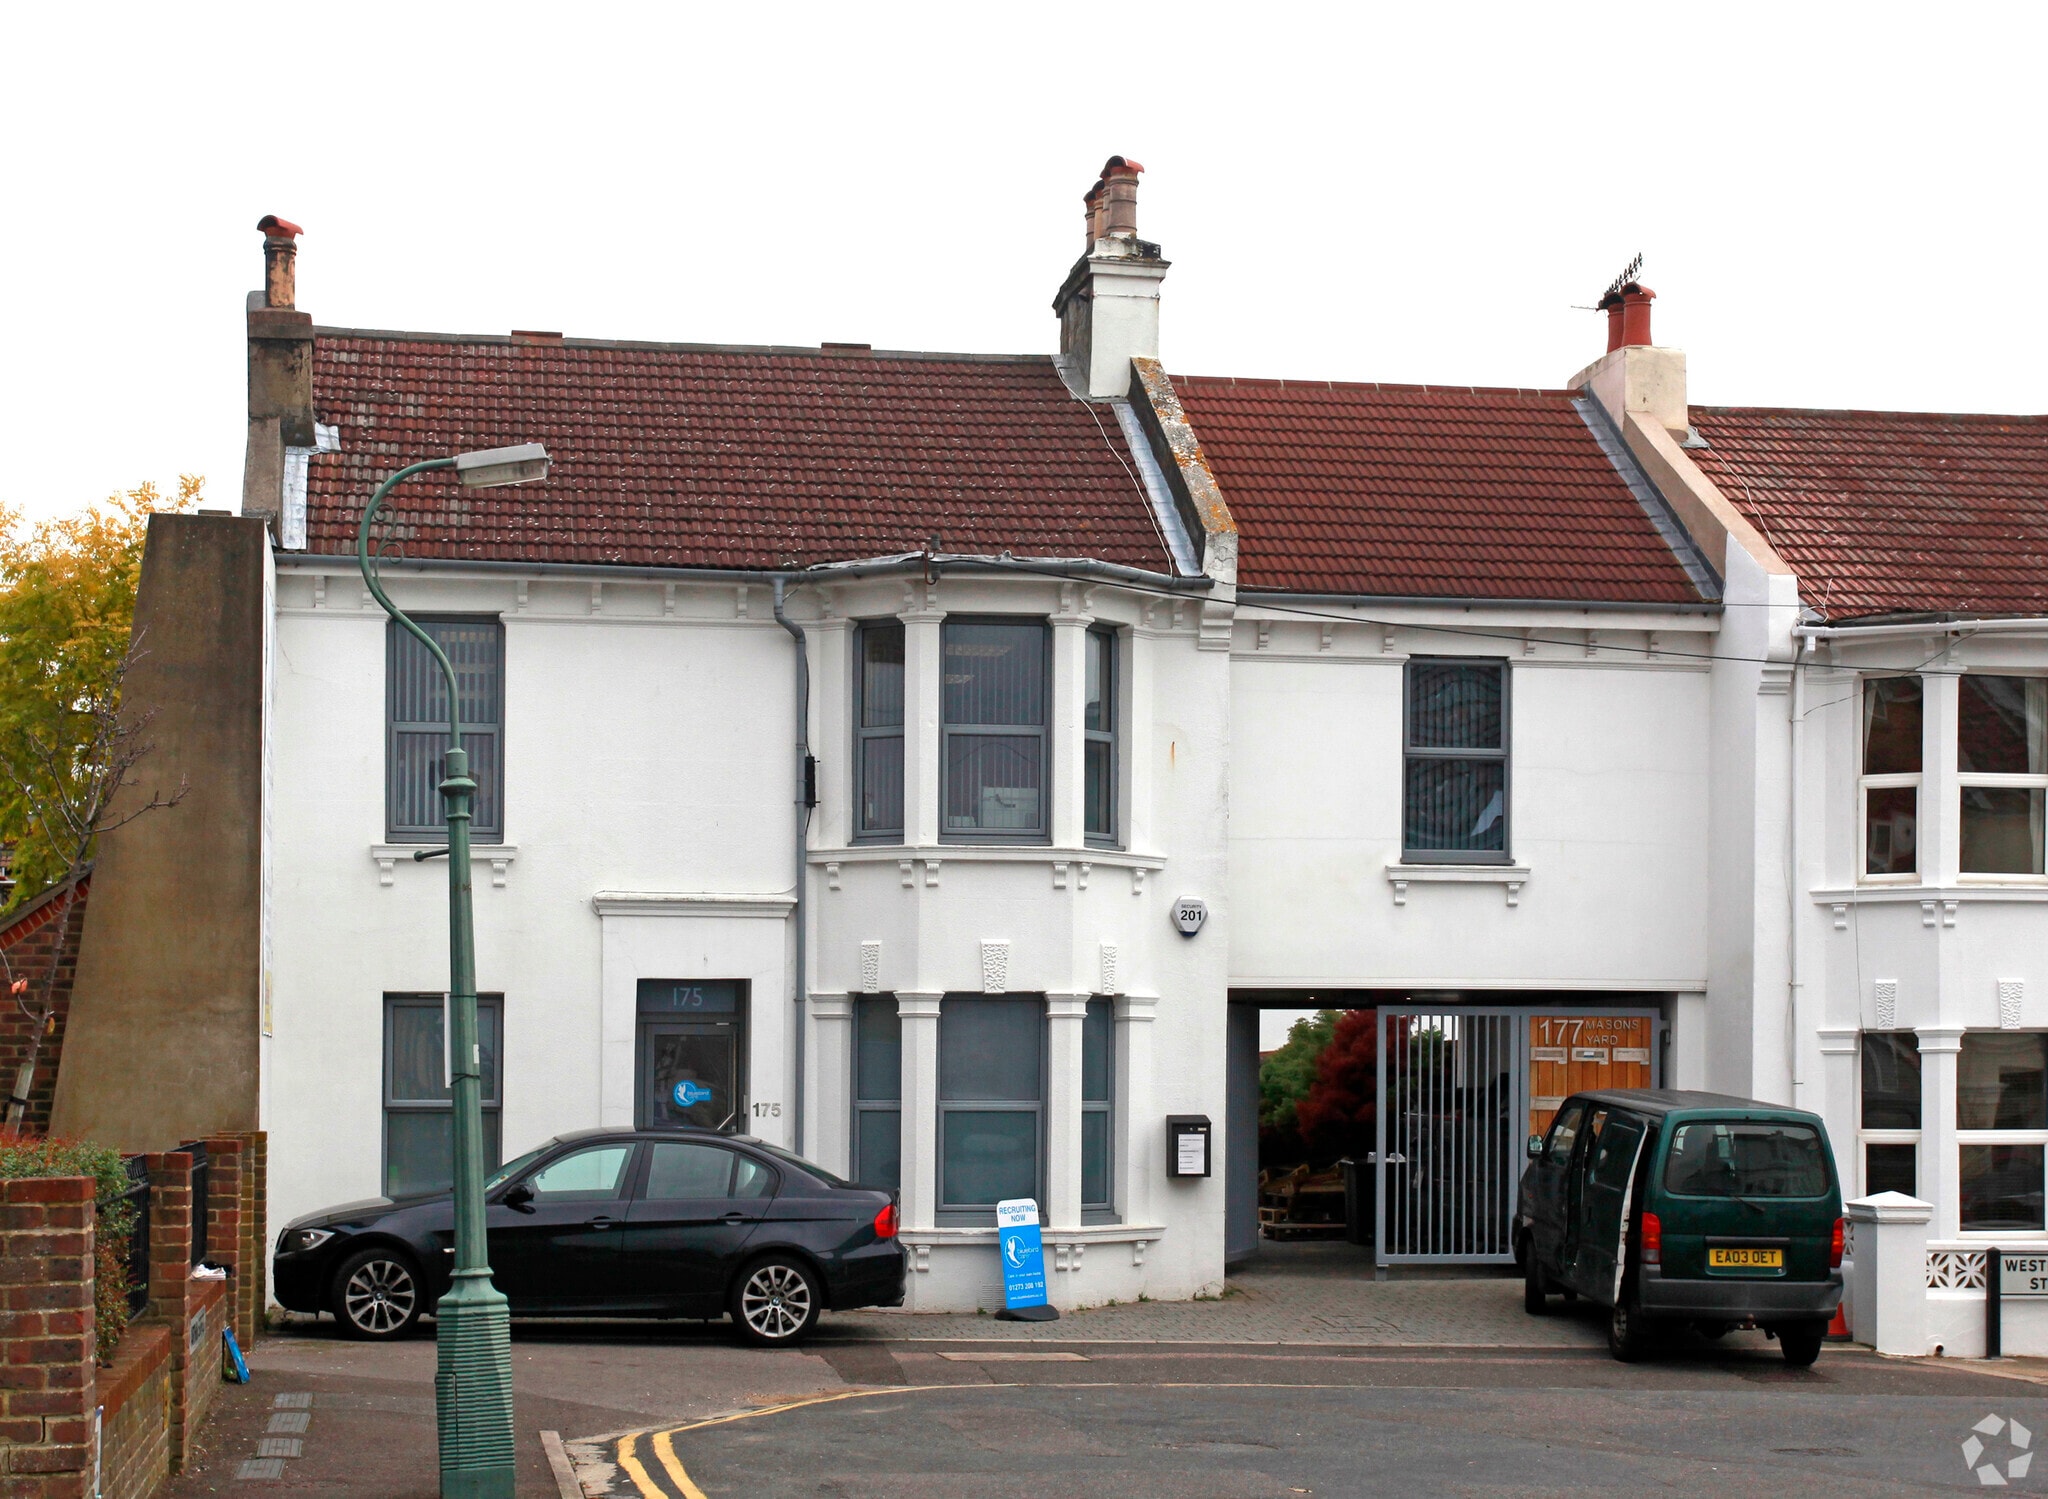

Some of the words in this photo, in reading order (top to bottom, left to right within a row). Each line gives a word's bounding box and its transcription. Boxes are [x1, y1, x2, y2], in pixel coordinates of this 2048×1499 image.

[1180, 910, 1202, 921] 201
[673, 987, 703, 1006] 175
[1540, 1019, 1584, 1045] 177
[1585, 1019, 1639, 1030] MASONS
[1586, 1034, 1618, 1045] YARD
[752, 1102, 782, 1118] 175
[999, 1204, 1036, 1215] RECRUITING
[1011, 1214, 1026, 1222] NOW
[1716, 1250, 1749, 1264] EA03
[1752, 1250, 1776, 1264] OET
[2005, 1259, 2046, 1272] WEST
[2030, 1277, 2048, 1290] ST
